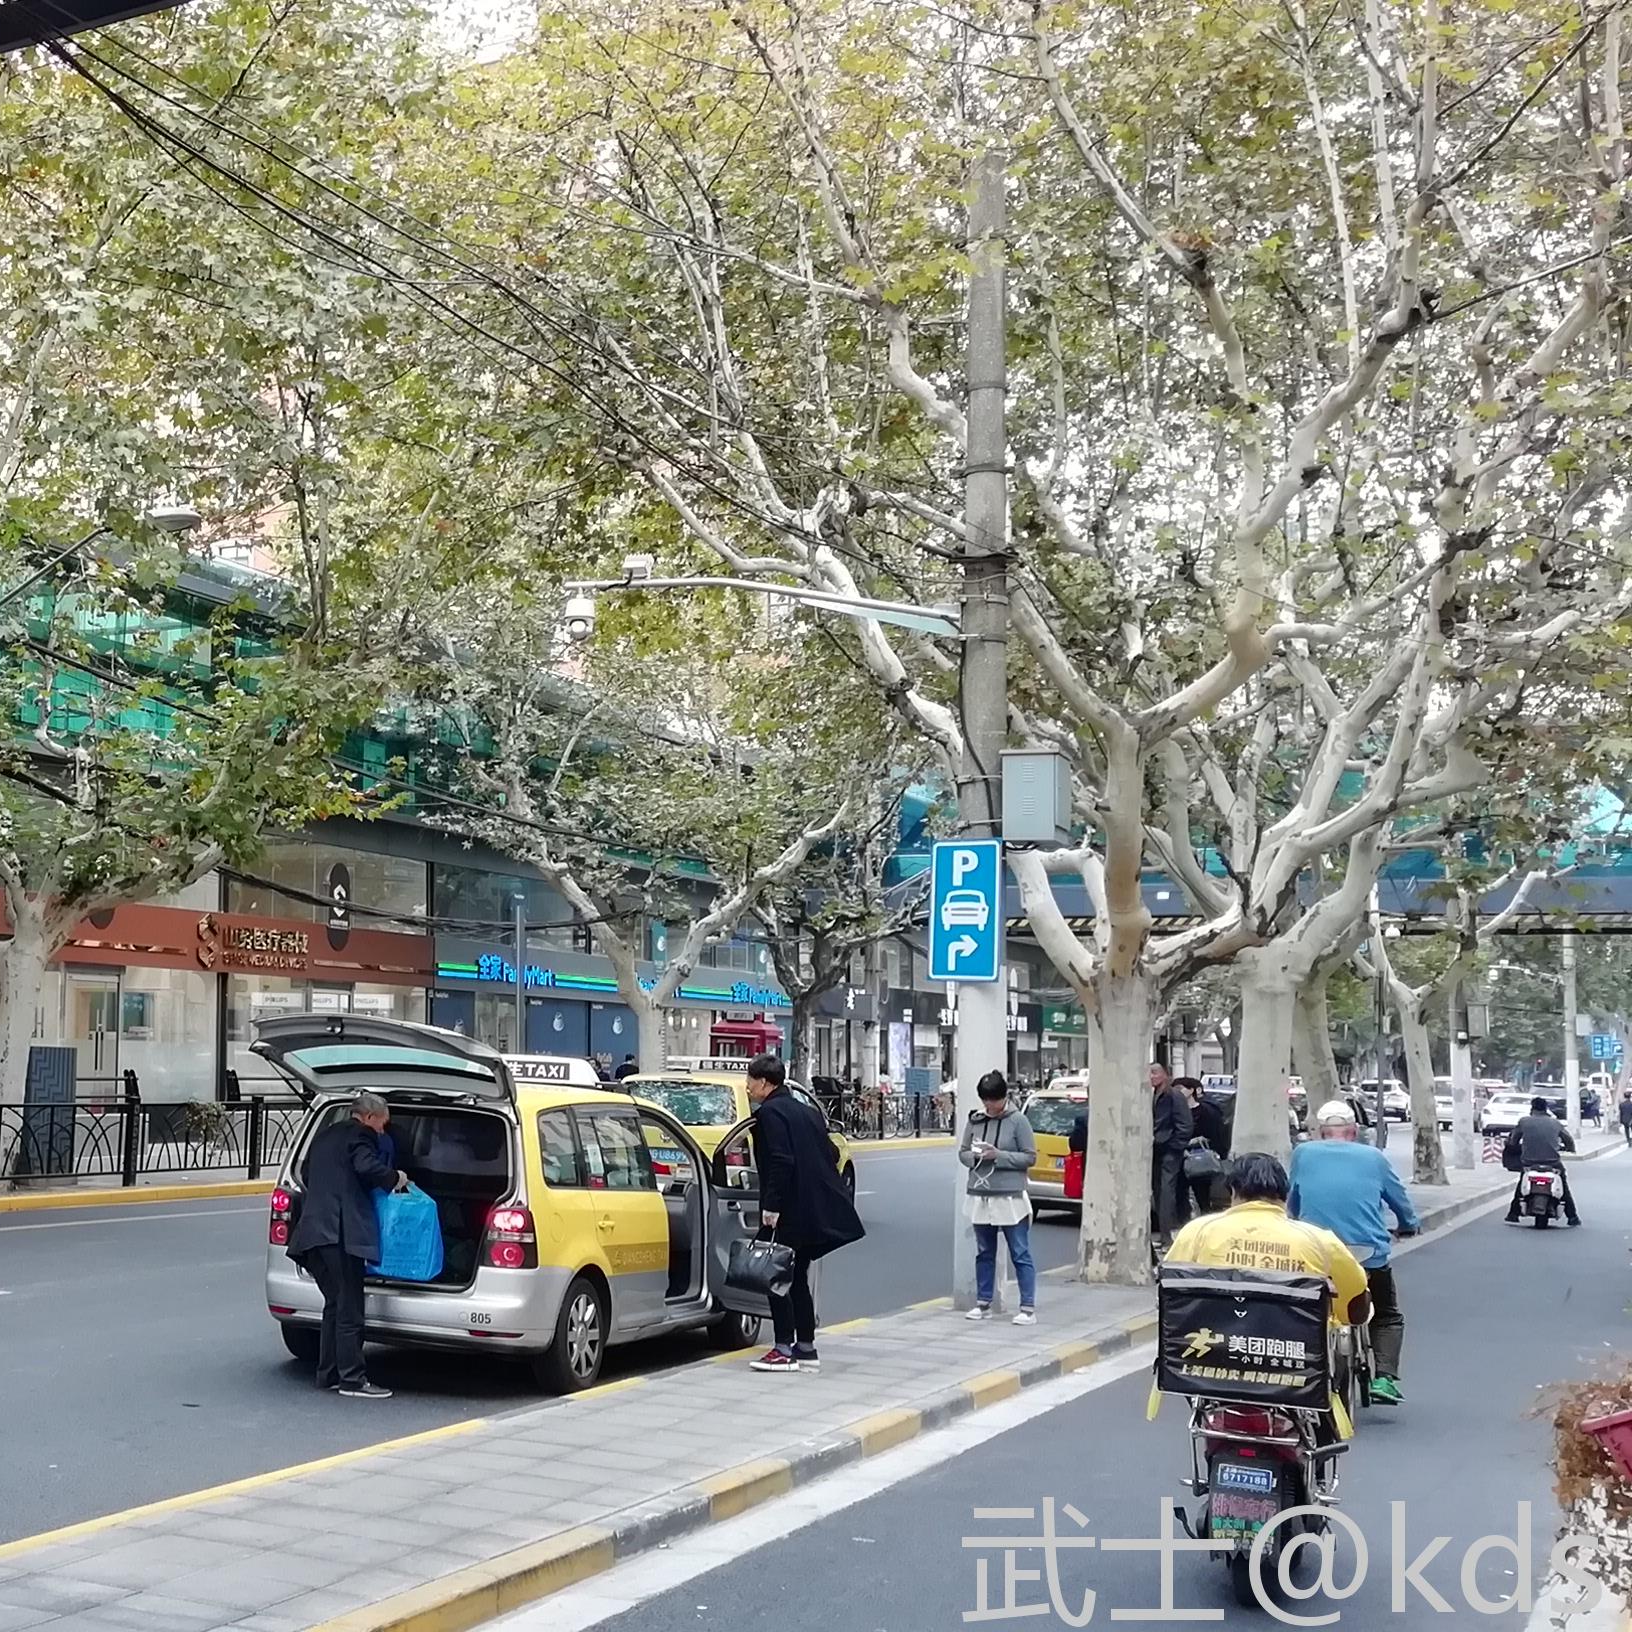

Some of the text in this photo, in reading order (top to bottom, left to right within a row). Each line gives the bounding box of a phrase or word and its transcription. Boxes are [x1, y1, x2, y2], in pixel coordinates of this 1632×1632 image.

[952, 850, 979, 886] P
[470, 1312, 492, 1324] 805
[1228, 1335, 1306, 1360] 美团跑腿
